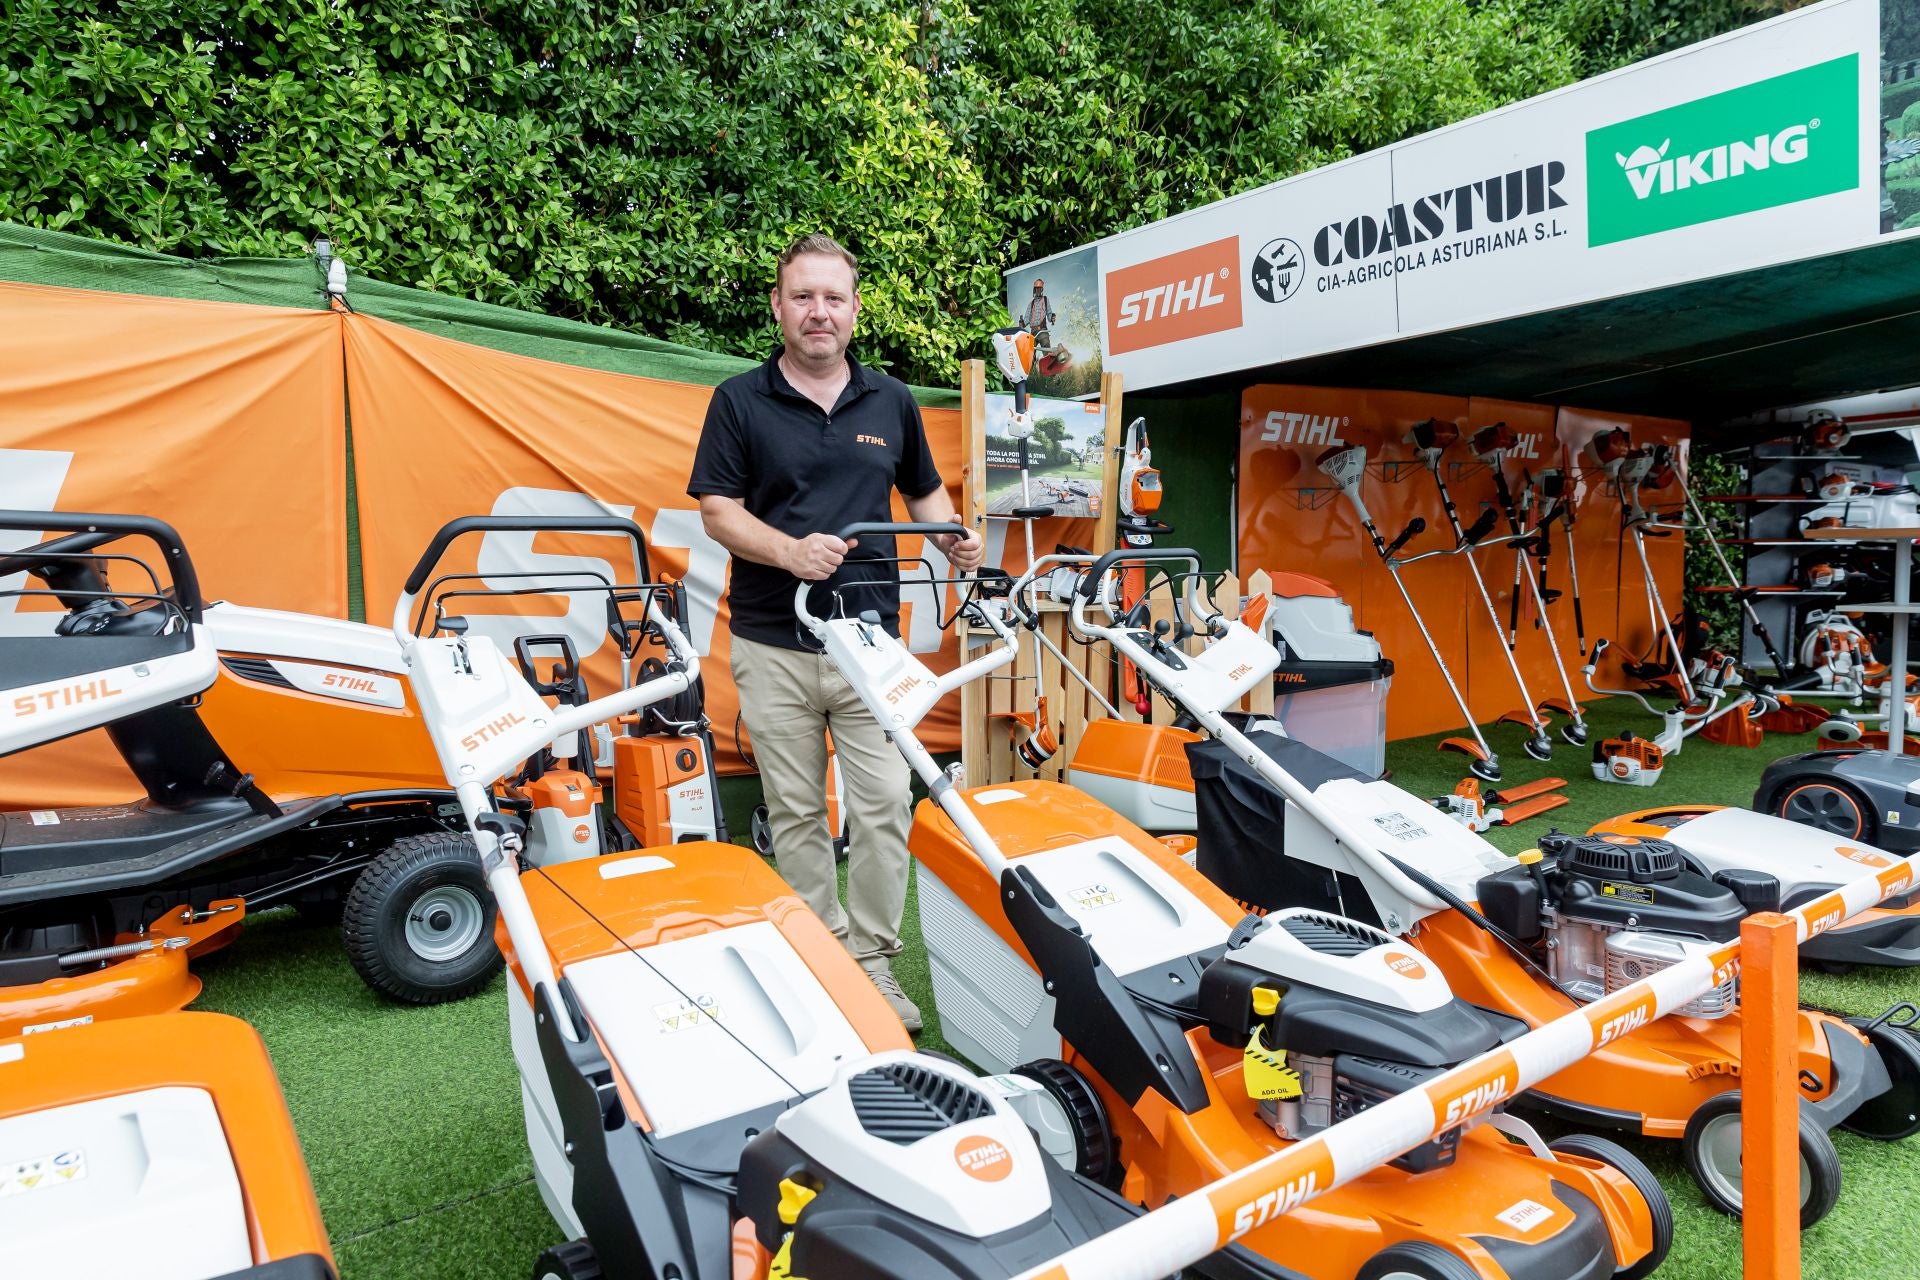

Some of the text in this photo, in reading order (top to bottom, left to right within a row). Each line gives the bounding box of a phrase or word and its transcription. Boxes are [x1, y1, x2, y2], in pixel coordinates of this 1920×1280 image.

[1625, 124, 1808, 200] VIKING
[1313, 160, 1569, 267] COASTUR
[1317, 218, 1568, 293] CIA-AGRICOLA ASTURIANA S.L.
[1117, 272, 1225, 328] STIHL
[856, 434, 887, 447] STIHL
[1260, 411, 1345, 447] STIHL
[322, 673, 378, 694] STIHL
[1228, 663, 1254, 681] STIHL
[13, 679, 123, 718] STIHL
[885, 675, 921, 705] STIHL
[461, 712, 526, 752] STIHL
[679, 788, 705, 798] STIHL
[1811, 909, 1840, 935] STIHL
[1389, 957, 1417, 971] STIHL
[1596, 1004, 1650, 1049] STIHL
[1380, 1061, 1424, 1080] HOT
[1441, 1074, 1510, 1129] STIHL
[959, 1142, 1005, 1168] STIHL
[1228, 1171, 1323, 1241] STIHL
[1510, 1204, 1542, 1224] STIHL
